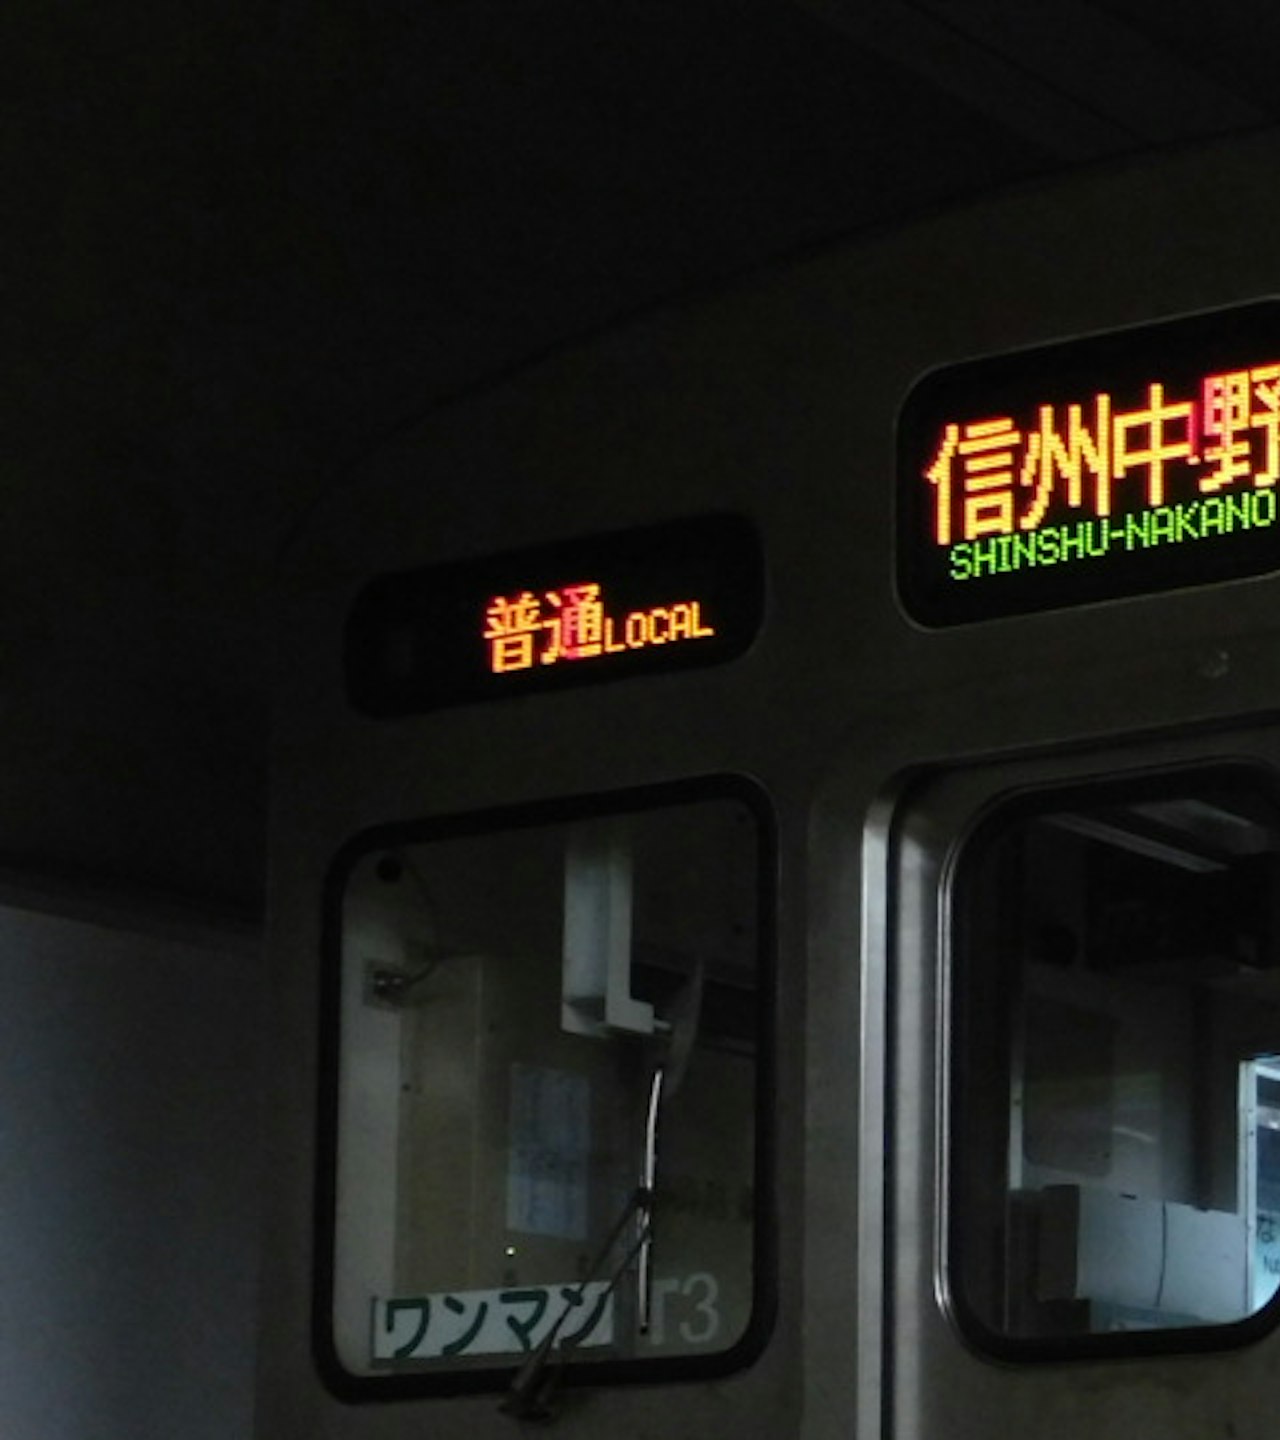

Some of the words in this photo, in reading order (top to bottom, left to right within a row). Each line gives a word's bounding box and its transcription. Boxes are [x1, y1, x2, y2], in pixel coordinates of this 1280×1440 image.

[950, 488, 1276, 580] SHINSHU-NAKANO
[483, 583, 603, 673] 普通
[604, 601, 714, 652] LOCAL
[385, 1287, 610, 1359] ワンマン
